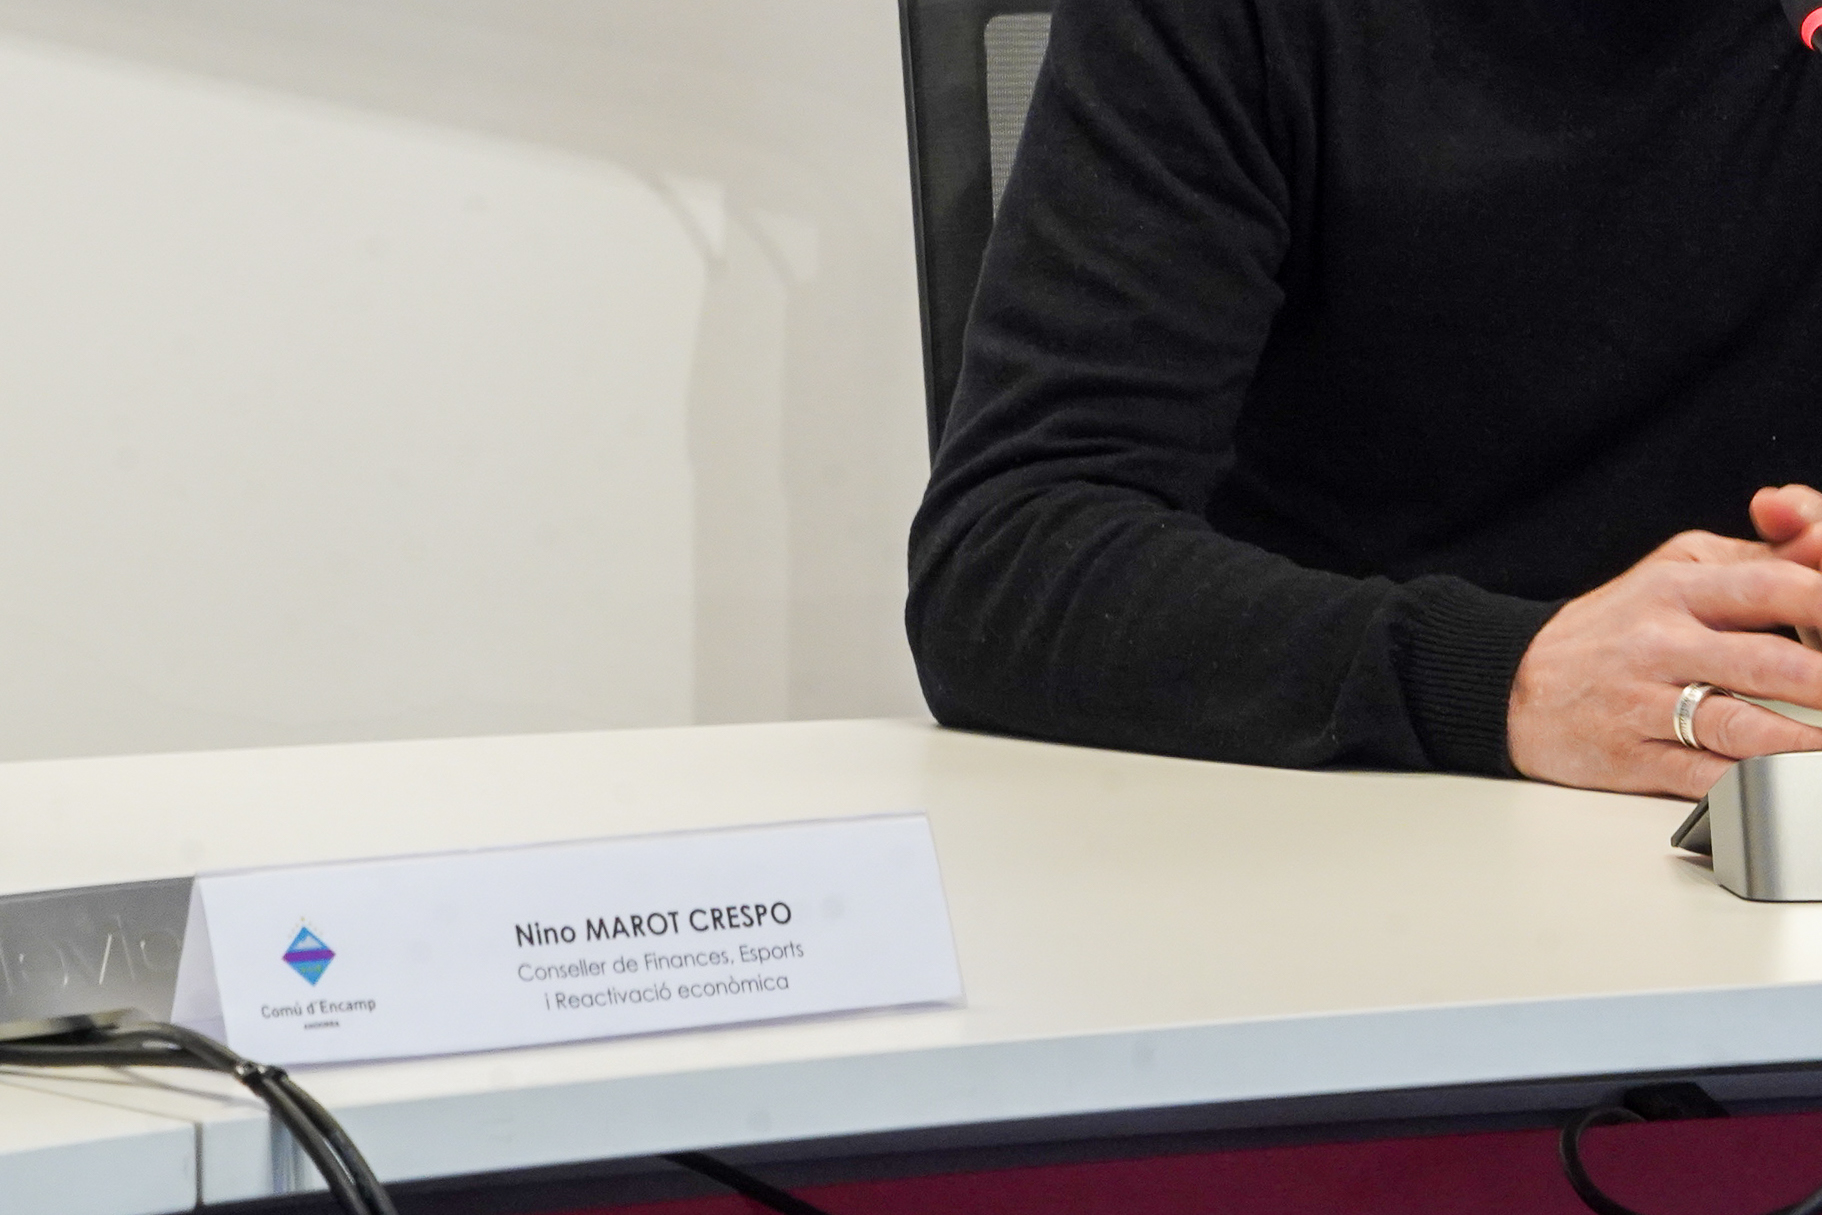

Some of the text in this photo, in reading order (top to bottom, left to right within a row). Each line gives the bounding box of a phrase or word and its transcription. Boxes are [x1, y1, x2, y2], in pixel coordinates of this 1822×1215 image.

[514, 901, 793, 948] Nino MAROT CRESPO
[517, 940, 805, 983] Conseller de Finances, Esports
[545, 974, 790, 1011] i Reactivació econòmica
